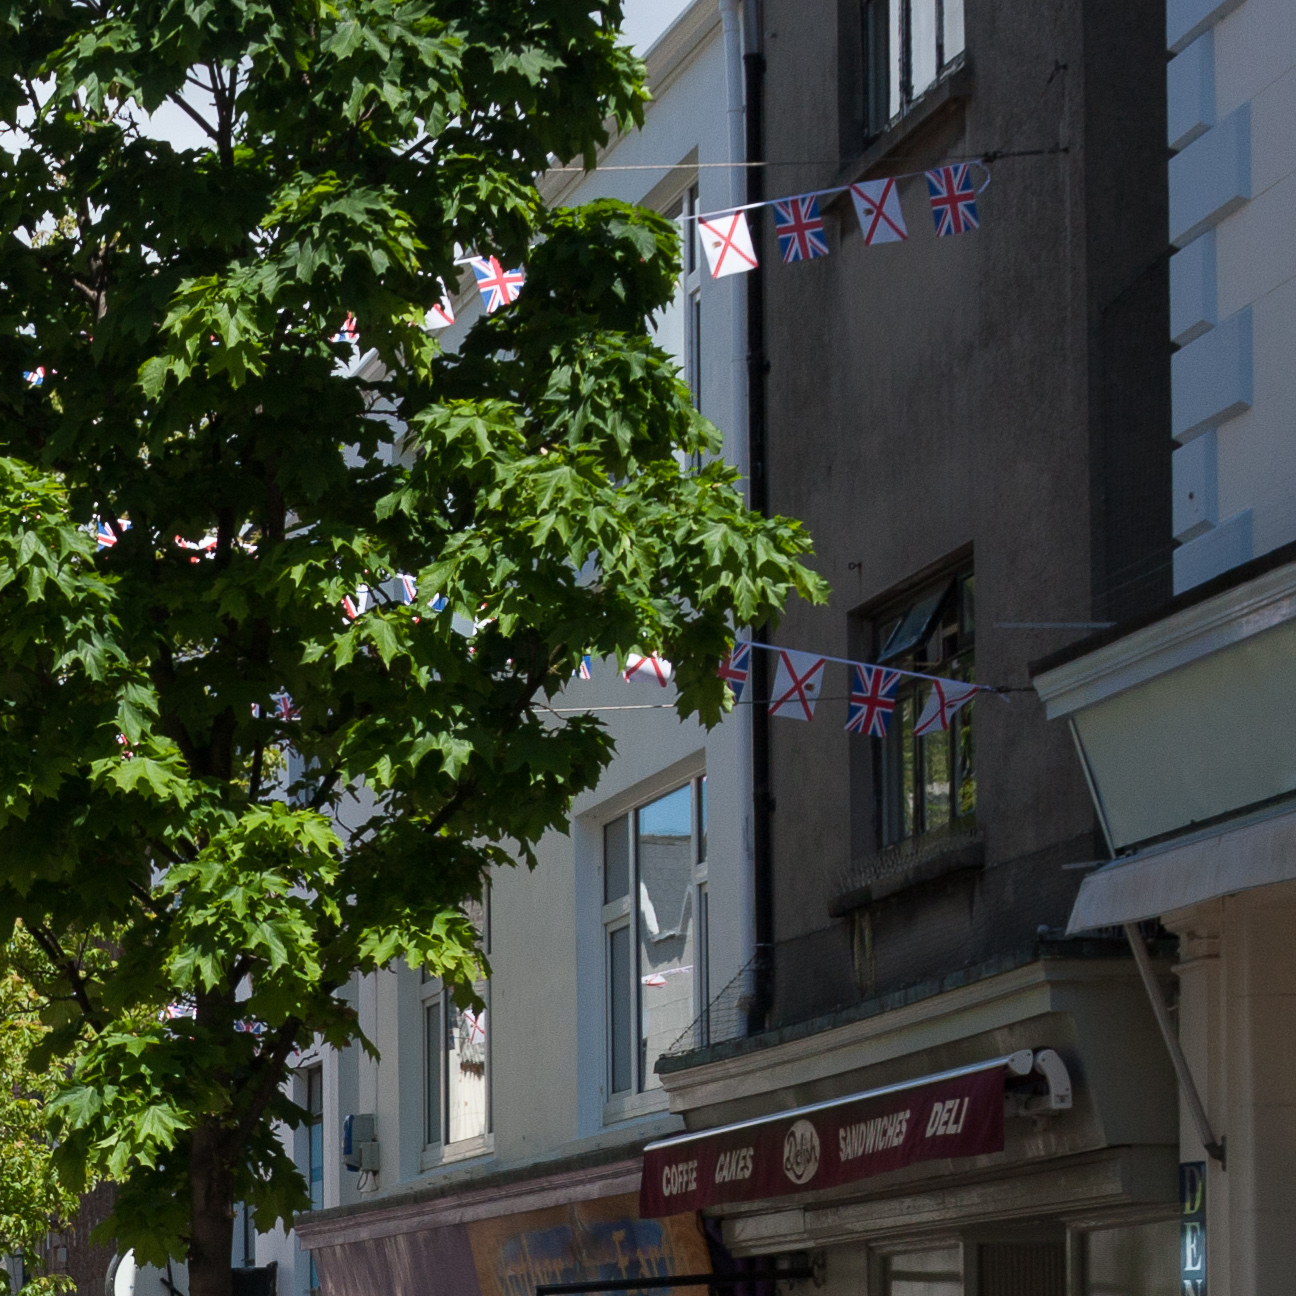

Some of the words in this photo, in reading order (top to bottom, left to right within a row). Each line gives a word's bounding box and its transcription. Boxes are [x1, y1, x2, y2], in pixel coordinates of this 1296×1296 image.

[661, 1159, 698, 1197] COFFEE
[715, 1146, 754, 1185] CAKES
[838, 1109, 911, 1162] SANDWICHES
[924, 1096, 970, 1139] DELI
